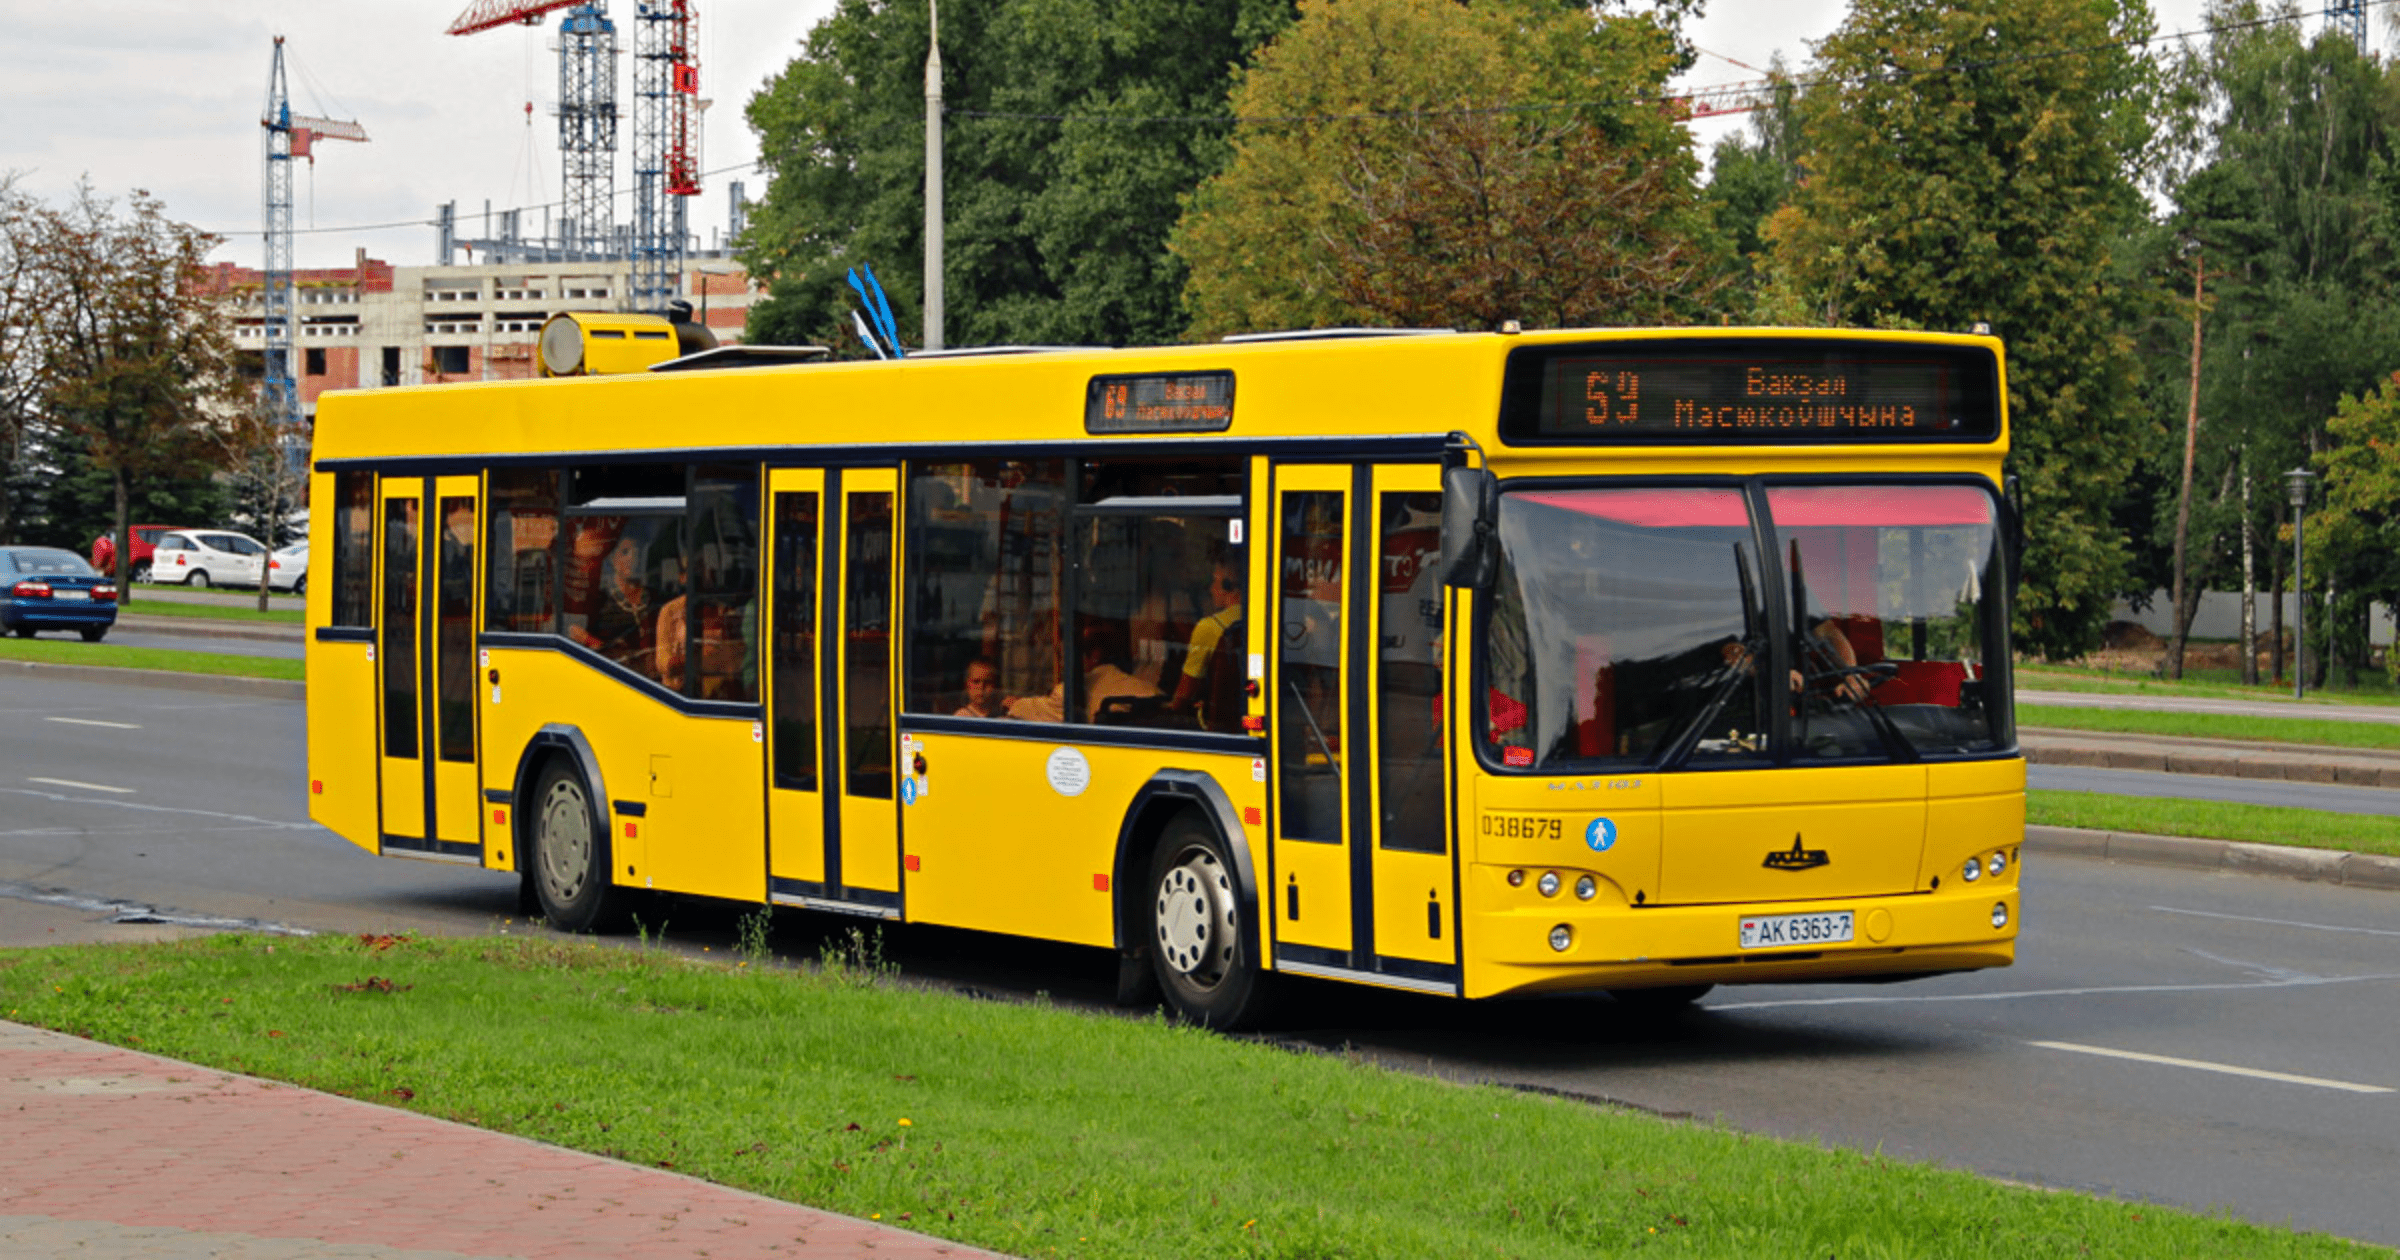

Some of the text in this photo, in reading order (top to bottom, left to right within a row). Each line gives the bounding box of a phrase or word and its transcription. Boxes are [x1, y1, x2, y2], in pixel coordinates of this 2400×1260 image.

[1586, 371, 1639, 425] 69
[1482, 815, 1562, 840] 038679
[1759, 920, 1785, 943] AK
[1789, 915, 1851, 941] 6363-7
